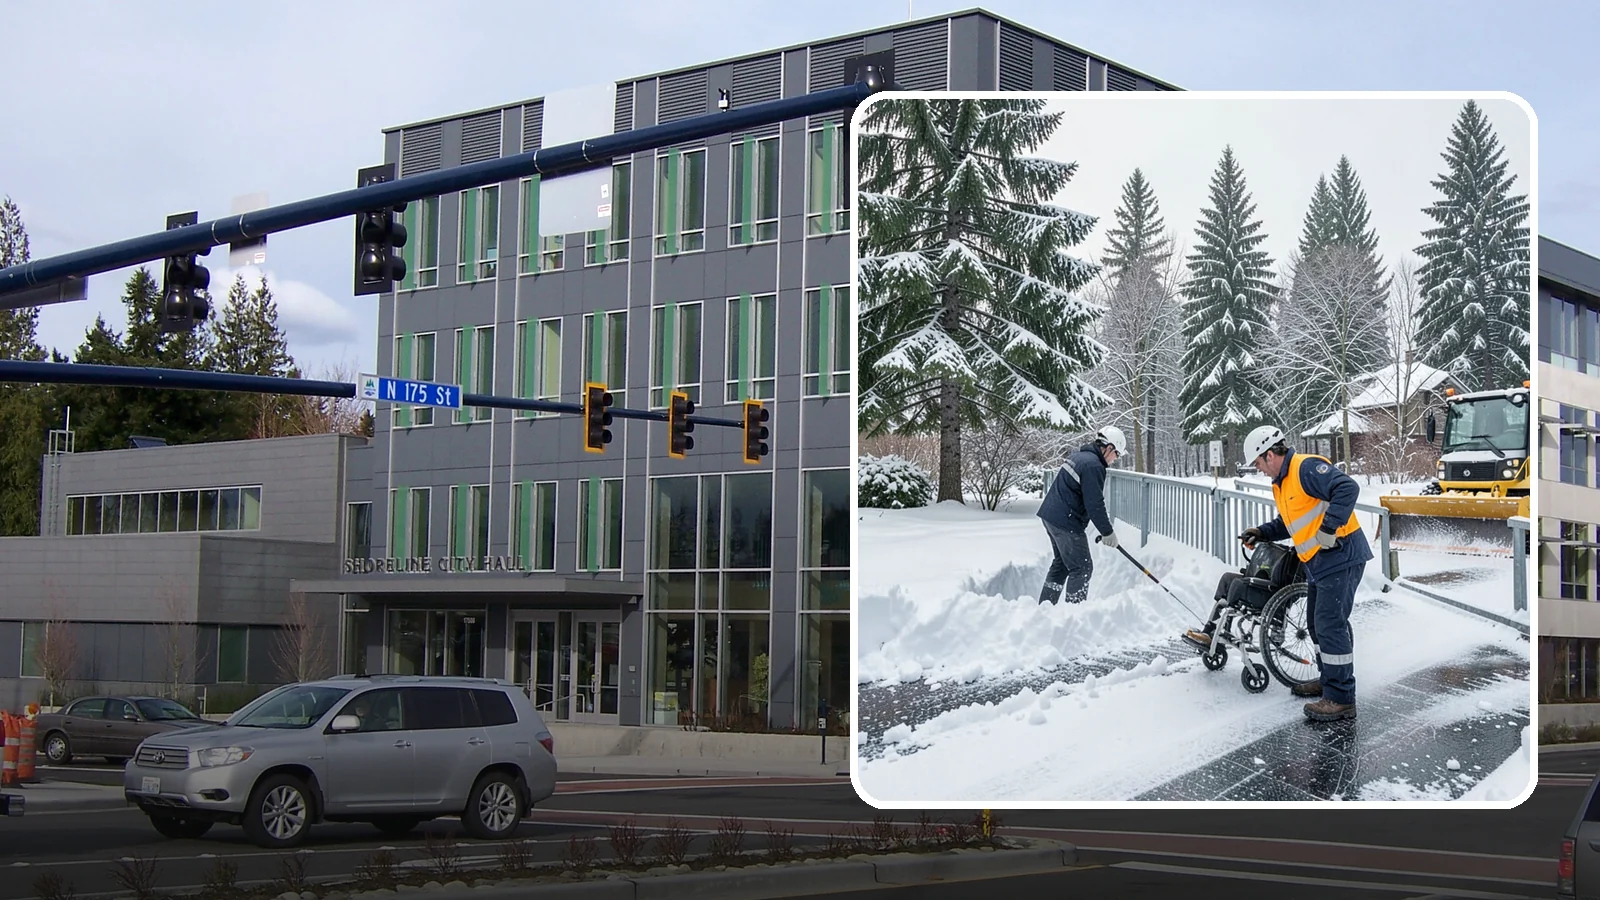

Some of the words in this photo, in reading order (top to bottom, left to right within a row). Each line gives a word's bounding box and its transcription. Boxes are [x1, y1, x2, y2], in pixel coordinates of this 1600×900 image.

[387, 380, 396, 399] N
[405, 382, 427, 403] 175
[436, 386, 452, 406] St
[344, 557, 431, 574] SHORELINE
[438, 556, 475, 572] CITY
[483, 555, 525, 571] HALL
